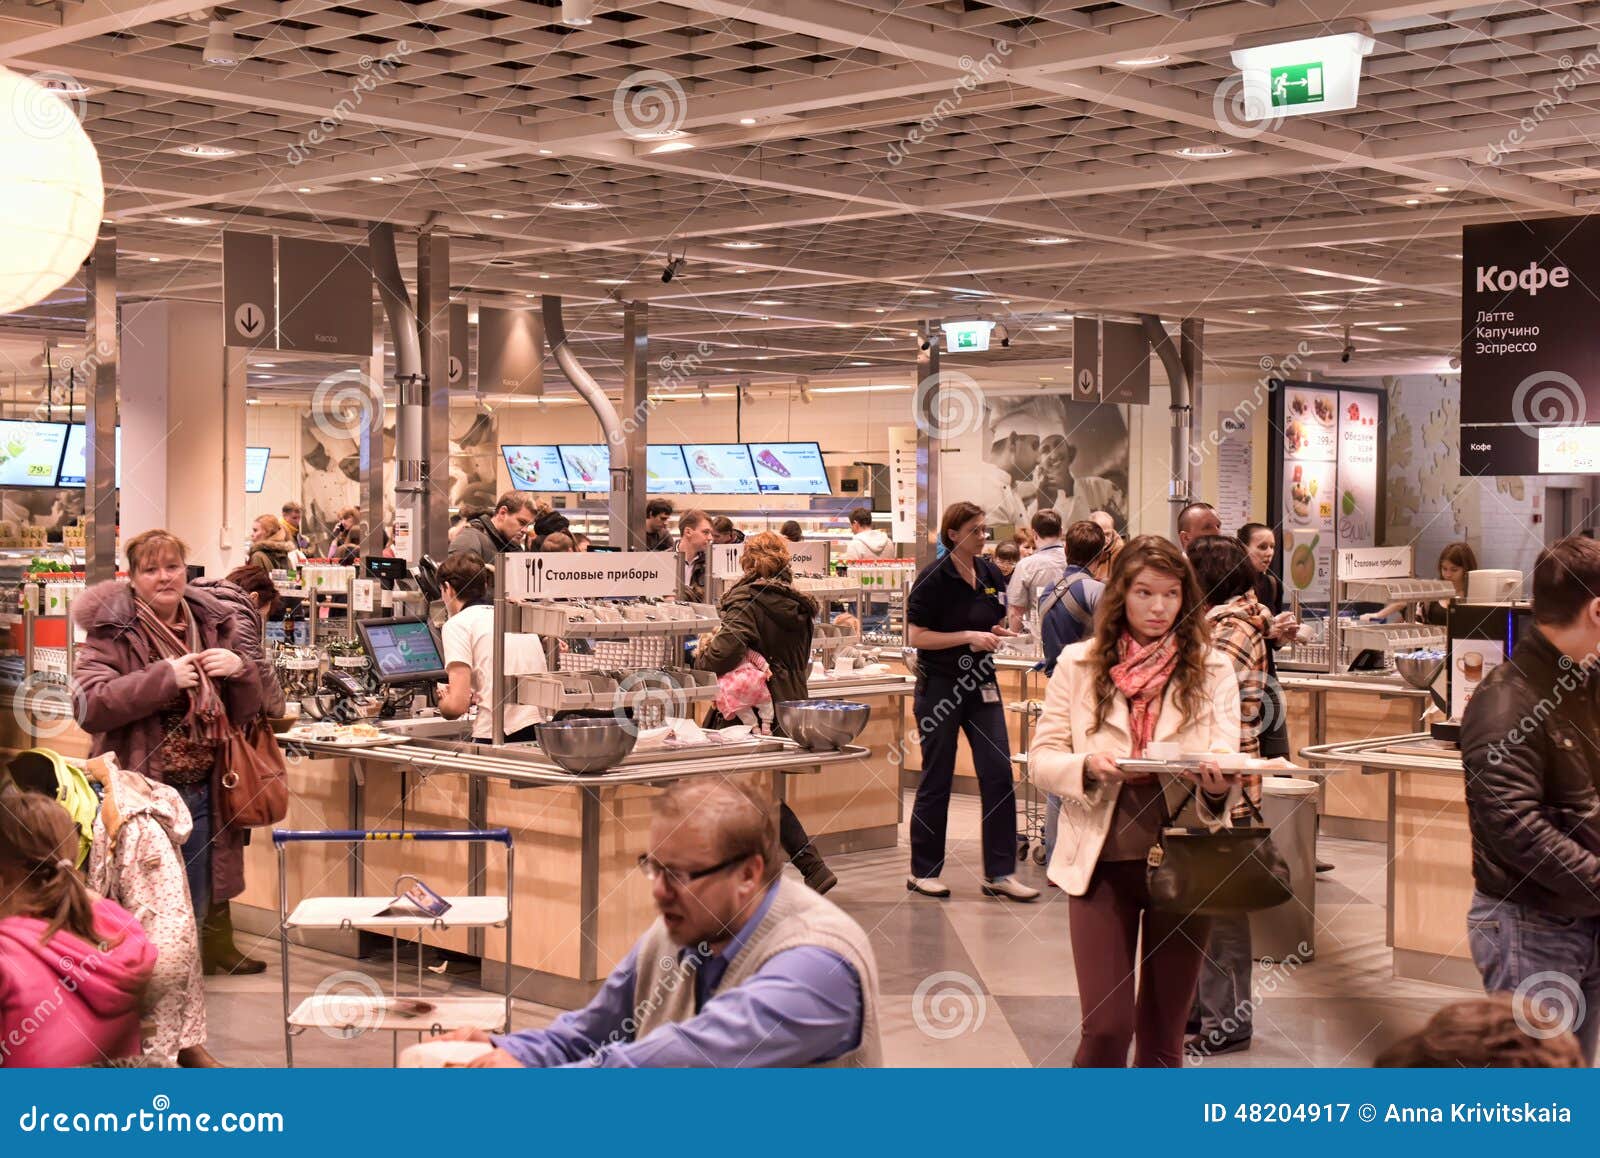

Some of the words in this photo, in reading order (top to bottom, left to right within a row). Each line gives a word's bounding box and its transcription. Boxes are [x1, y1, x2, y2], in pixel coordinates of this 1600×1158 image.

[1476, 262, 1569, 295] Кофе
[1476, 311, 1514, 322] Латте
[1476, 326, 1540, 340] Капучино
[1475, 342, 1537, 355] Эспрессо
[1470, 443, 1492, 451] Кофе
[545, 569, 604, 581] Столовые
[607, 568, 658, 582] приборы
